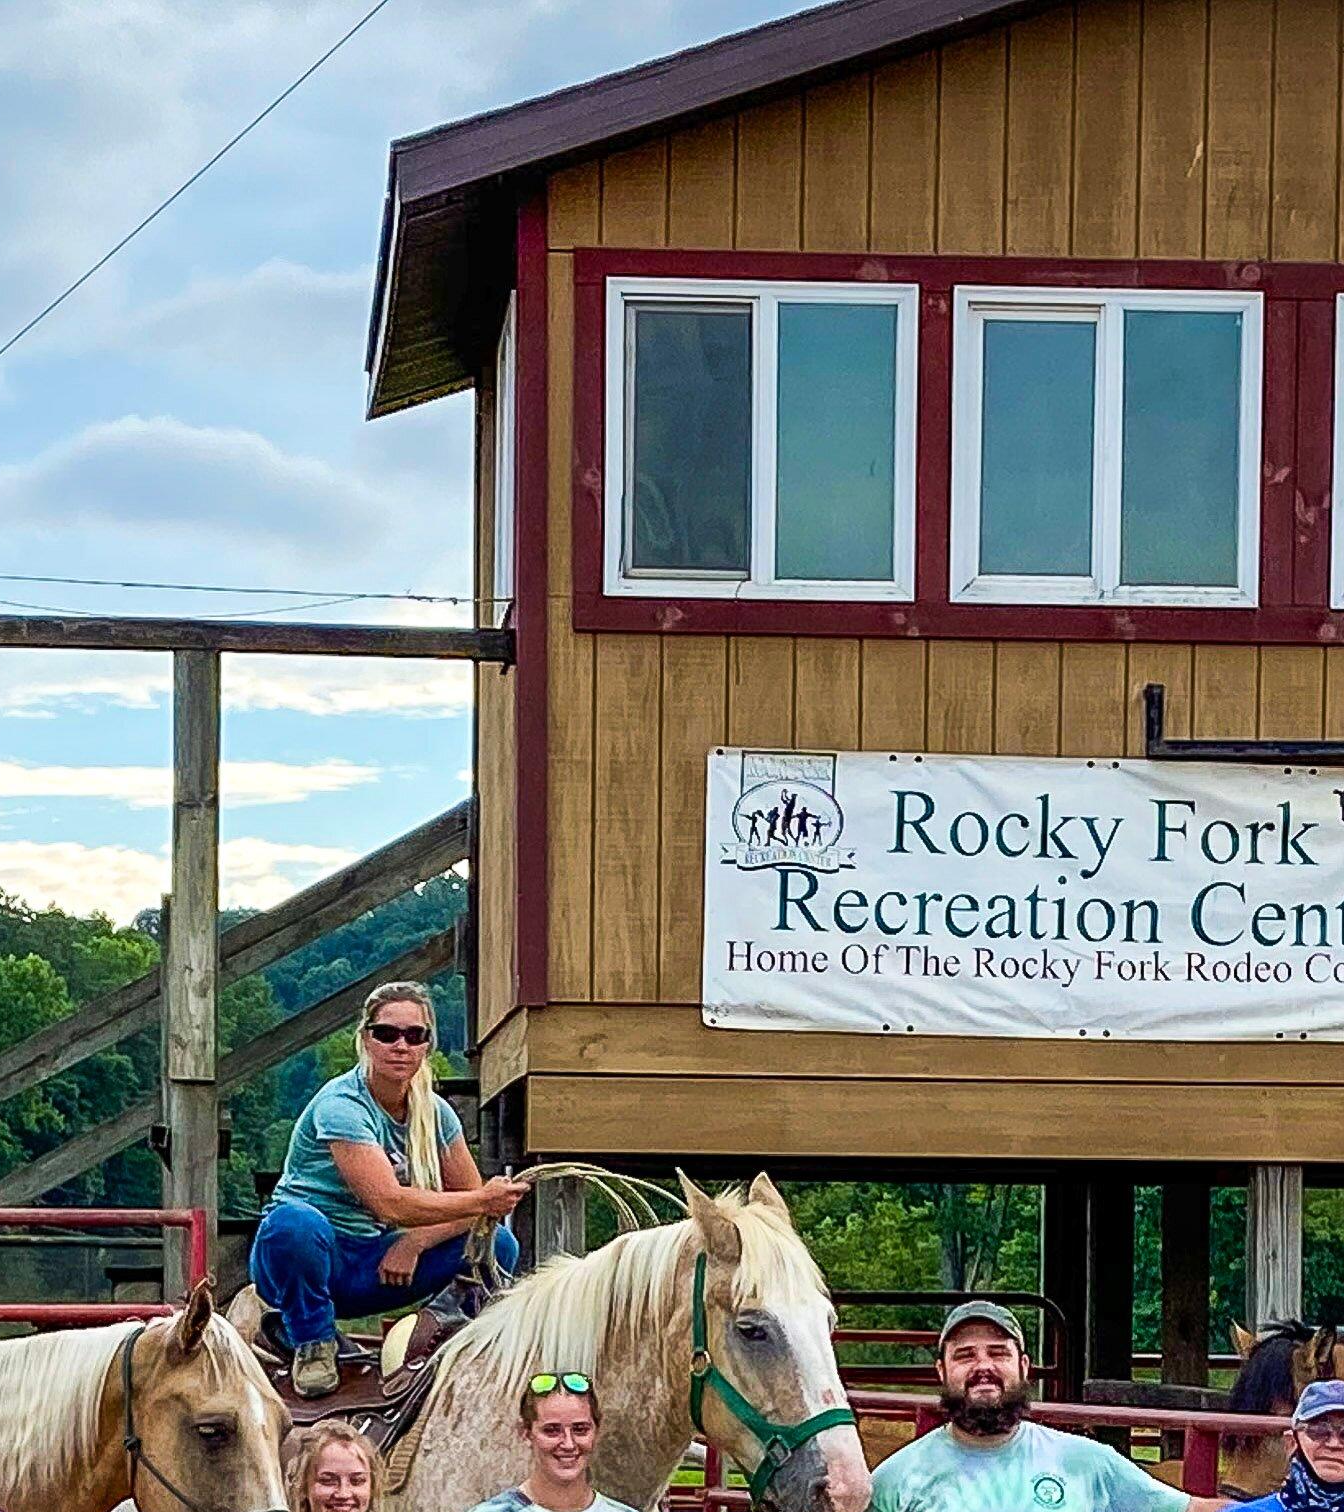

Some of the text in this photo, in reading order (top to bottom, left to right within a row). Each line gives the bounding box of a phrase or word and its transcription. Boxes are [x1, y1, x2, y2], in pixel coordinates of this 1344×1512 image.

[887, 790, 1320, 880] Rocky Fork
[772, 868, 1162, 944] Recreation
[726, 940, 829, 973] Home
[842, 944, 892, 975] Of
[894, 945, 961, 977] The
[974, 948, 1082, 988] Rocky
[1094, 950, 1172, 982] Fork
[1186, 950, 1293, 983] Rodeo
